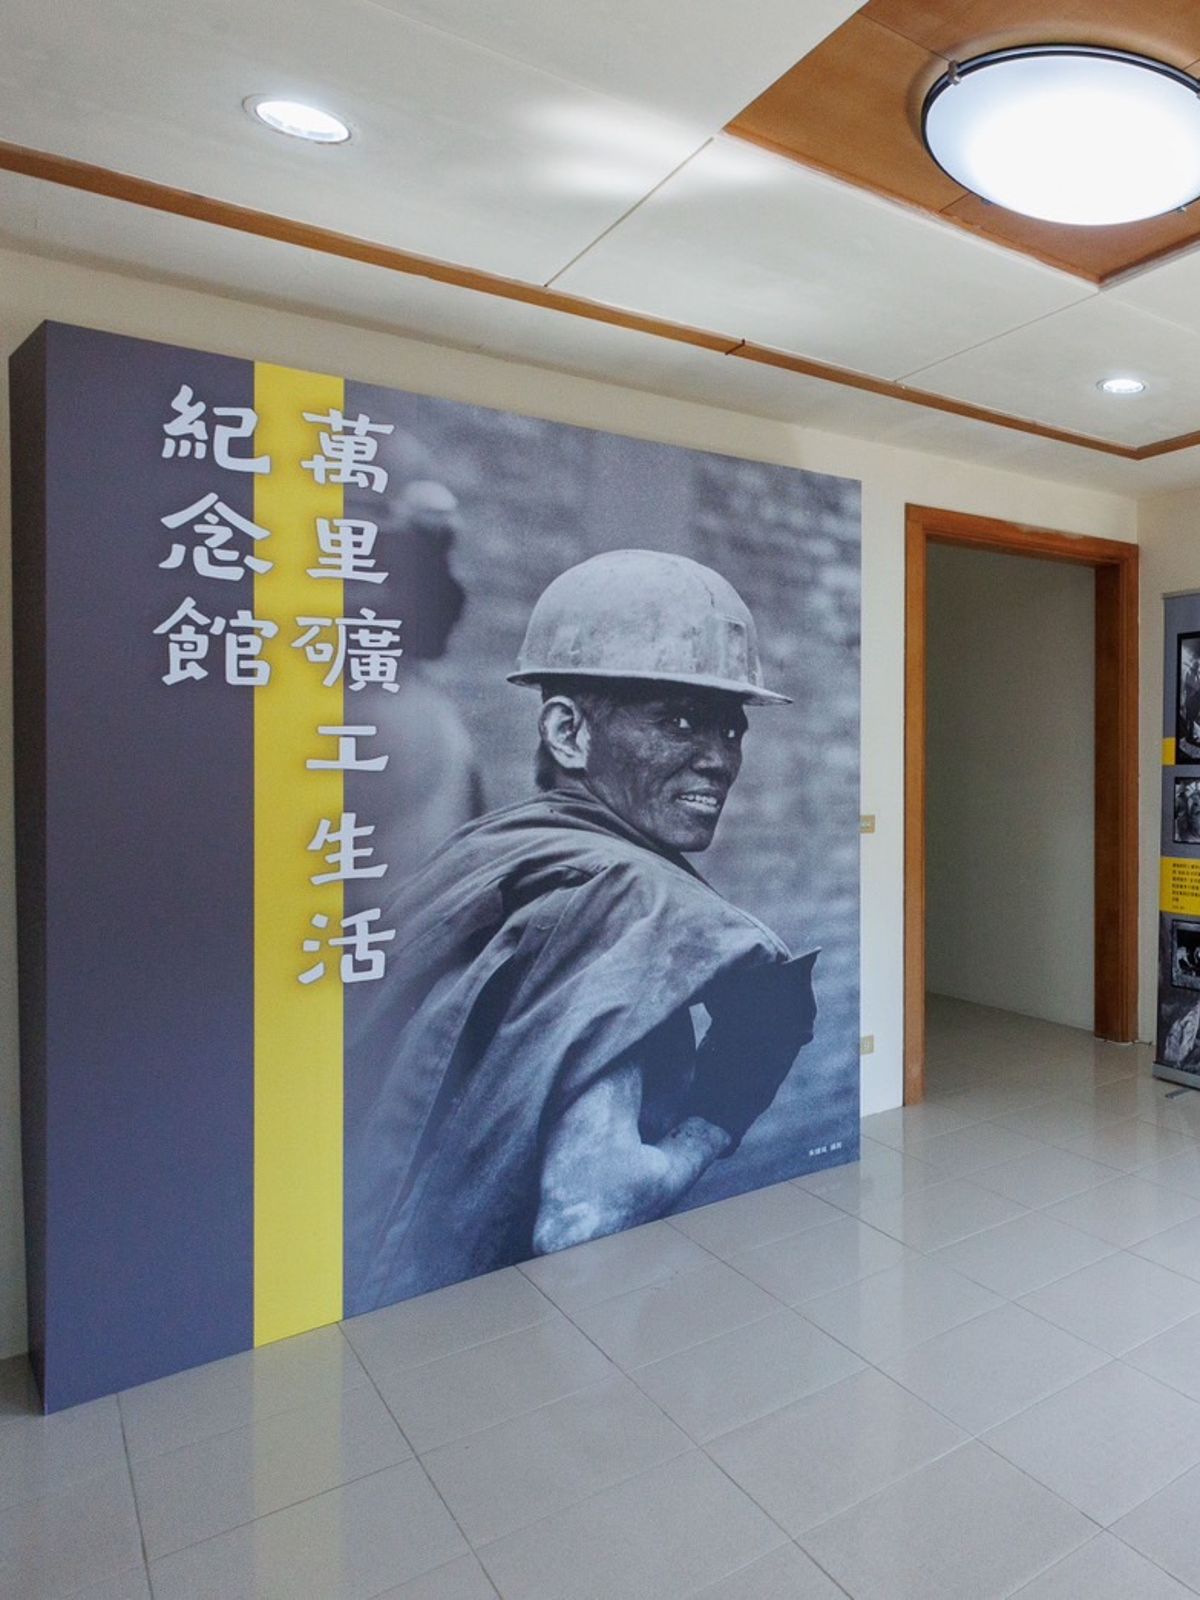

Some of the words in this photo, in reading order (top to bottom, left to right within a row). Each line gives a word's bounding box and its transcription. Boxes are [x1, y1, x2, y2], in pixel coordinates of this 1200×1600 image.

[152, 384, 280, 688] 紀念館
[290, 407, 404, 986] 萬里礦工生活
